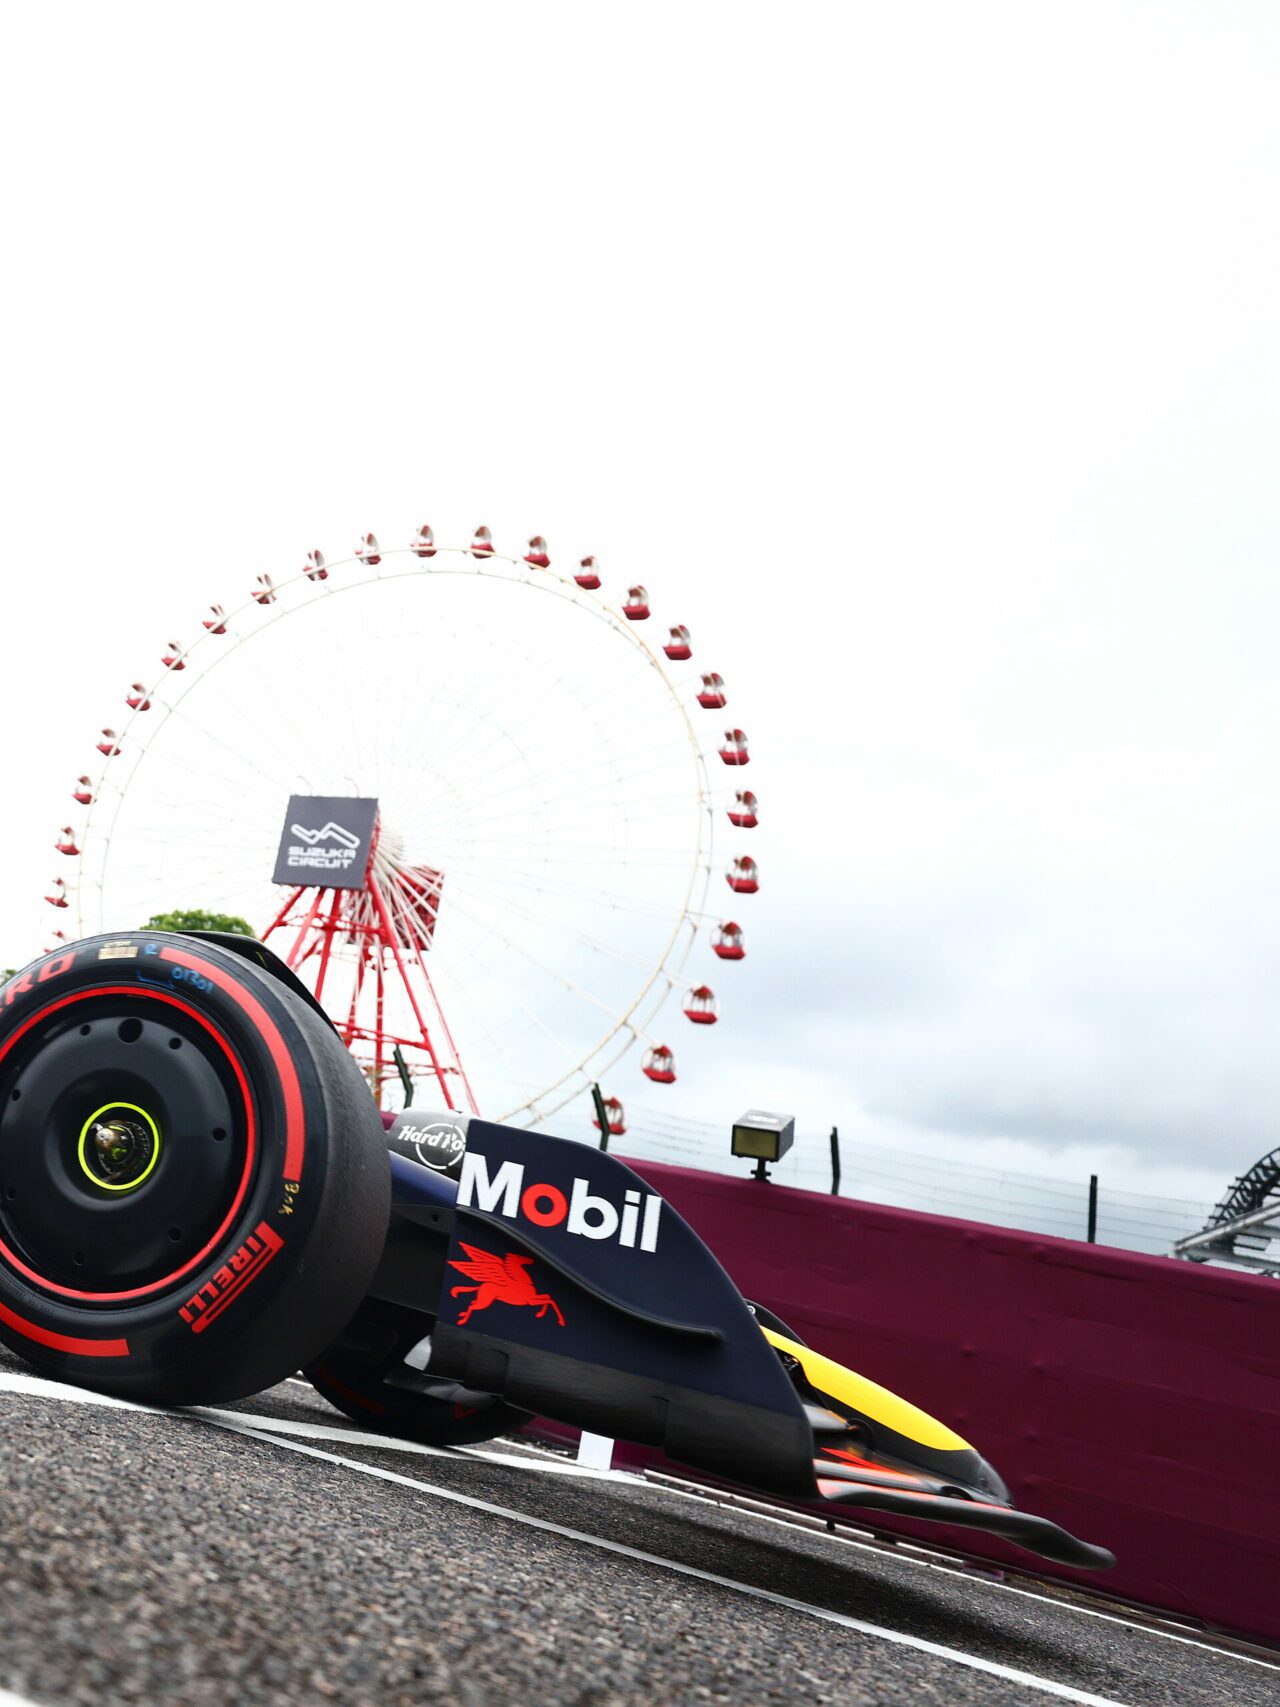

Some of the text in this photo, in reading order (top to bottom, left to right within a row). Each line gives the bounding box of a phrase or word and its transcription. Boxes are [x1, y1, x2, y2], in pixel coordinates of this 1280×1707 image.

[287, 846, 356, 859] SUZUKA
[287, 857, 353, 869] CIRCUIT
[398, 1125, 444, 1147] Hard
[456, 1151, 663, 1253] Mobil
[178, 1221, 286, 1333] PIRELLI
